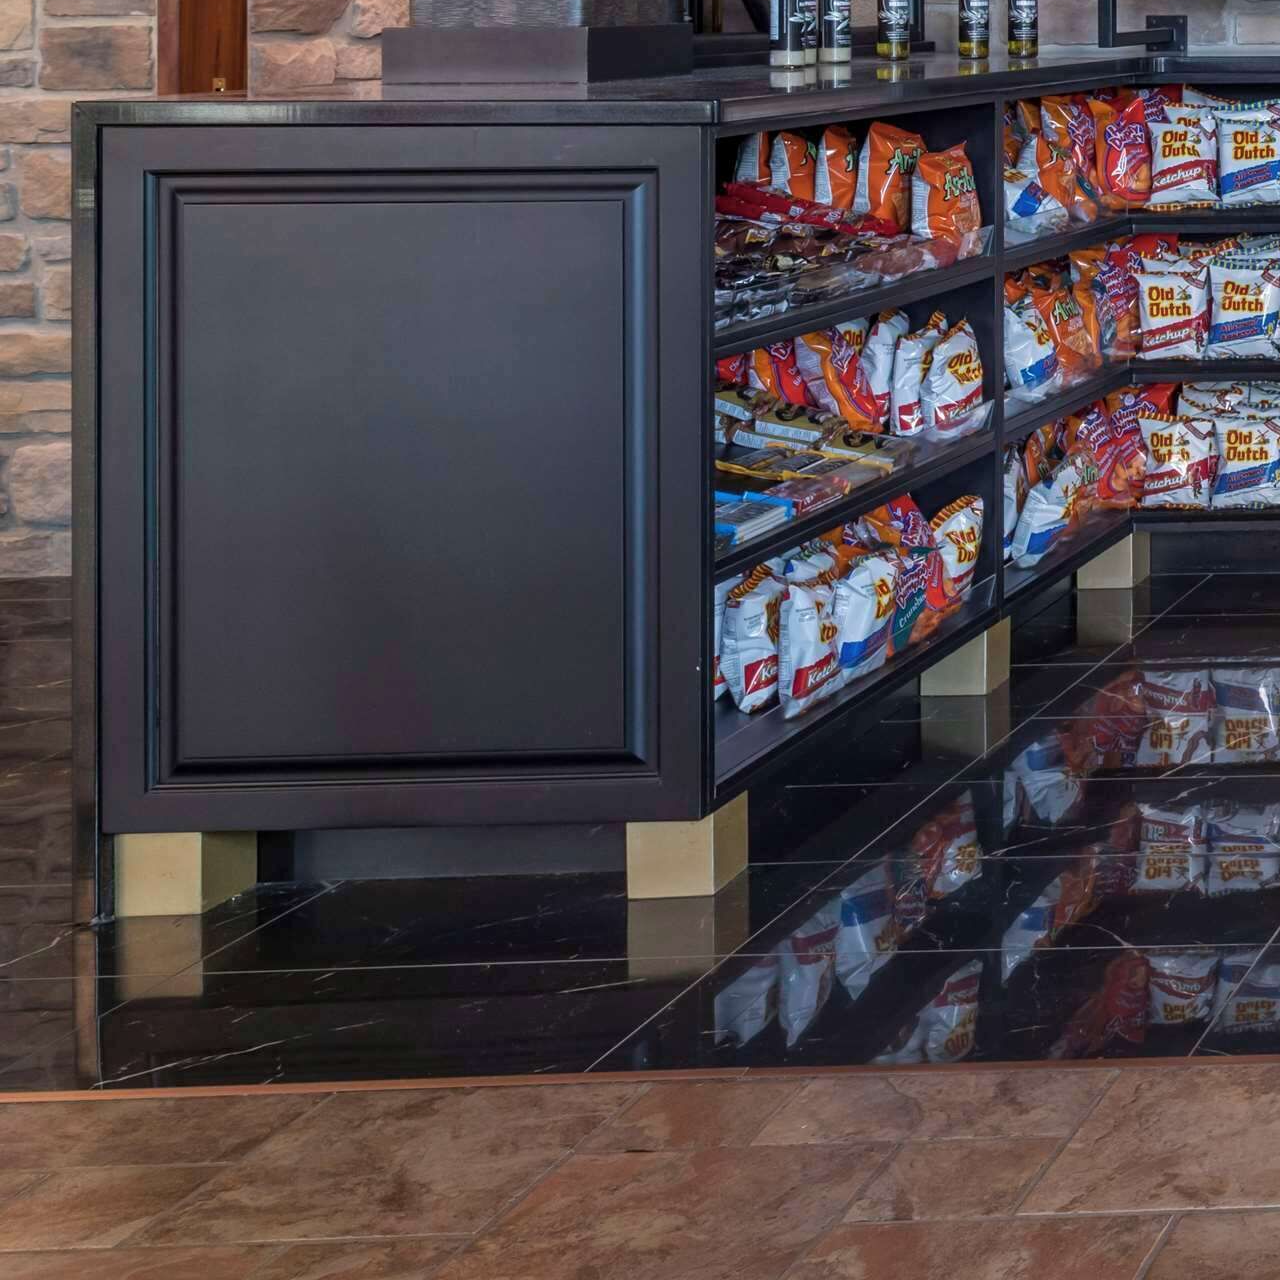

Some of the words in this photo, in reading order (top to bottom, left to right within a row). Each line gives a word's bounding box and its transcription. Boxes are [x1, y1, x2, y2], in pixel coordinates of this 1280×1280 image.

[1162, 130, 1188, 145] Old
[1232, 131, 1260, 145] Old
[1162, 144, 1200, 160] Dutch
[1232, 145, 1276, 160] Dutch
[1152, 166, 1201, 187] Ketchup
[1148, 285, 1175, 302] Old
[1222, 280, 1250, 296] Old
[1148, 302, 1192, 318] Dutch
[1221, 296, 1264, 313] Dutch
[1143, 327, 1190, 348] Ketchup
[948, 351, 974, 370] Old
[1151, 432, 1173, 447] Old
[1226, 429, 1252, 446] Old
[1226, 446, 1269, 462] Dutch
[1144, 471, 1187, 489] Ketchup
[947, 527, 976, 544] Old
